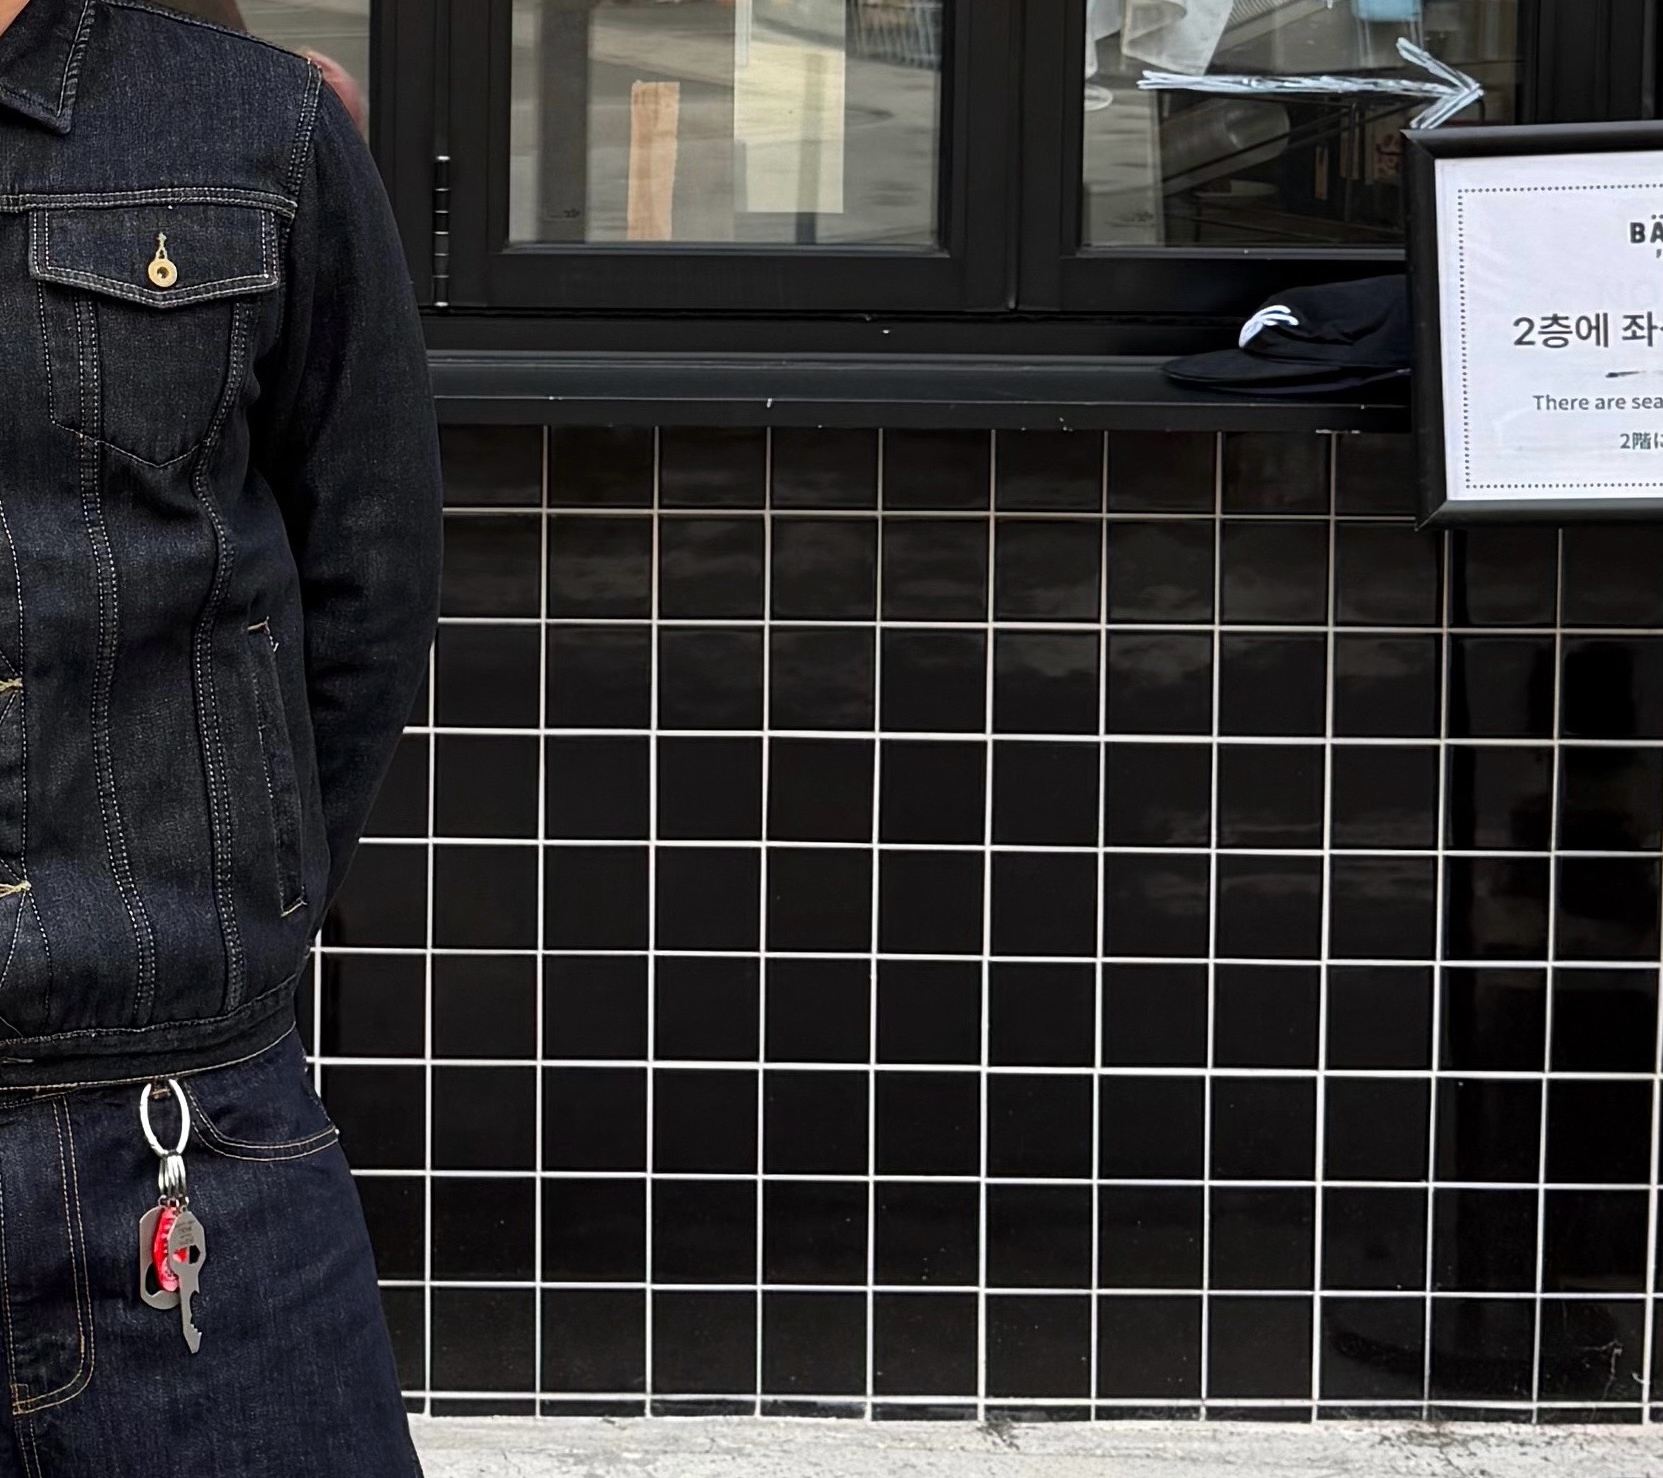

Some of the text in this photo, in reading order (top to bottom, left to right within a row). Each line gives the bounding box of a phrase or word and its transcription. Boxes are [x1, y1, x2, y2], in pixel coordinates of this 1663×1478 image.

[1513, 311, 1663, 348] 2층에 좌
[1532, 394, 1663, 410] There are sea
